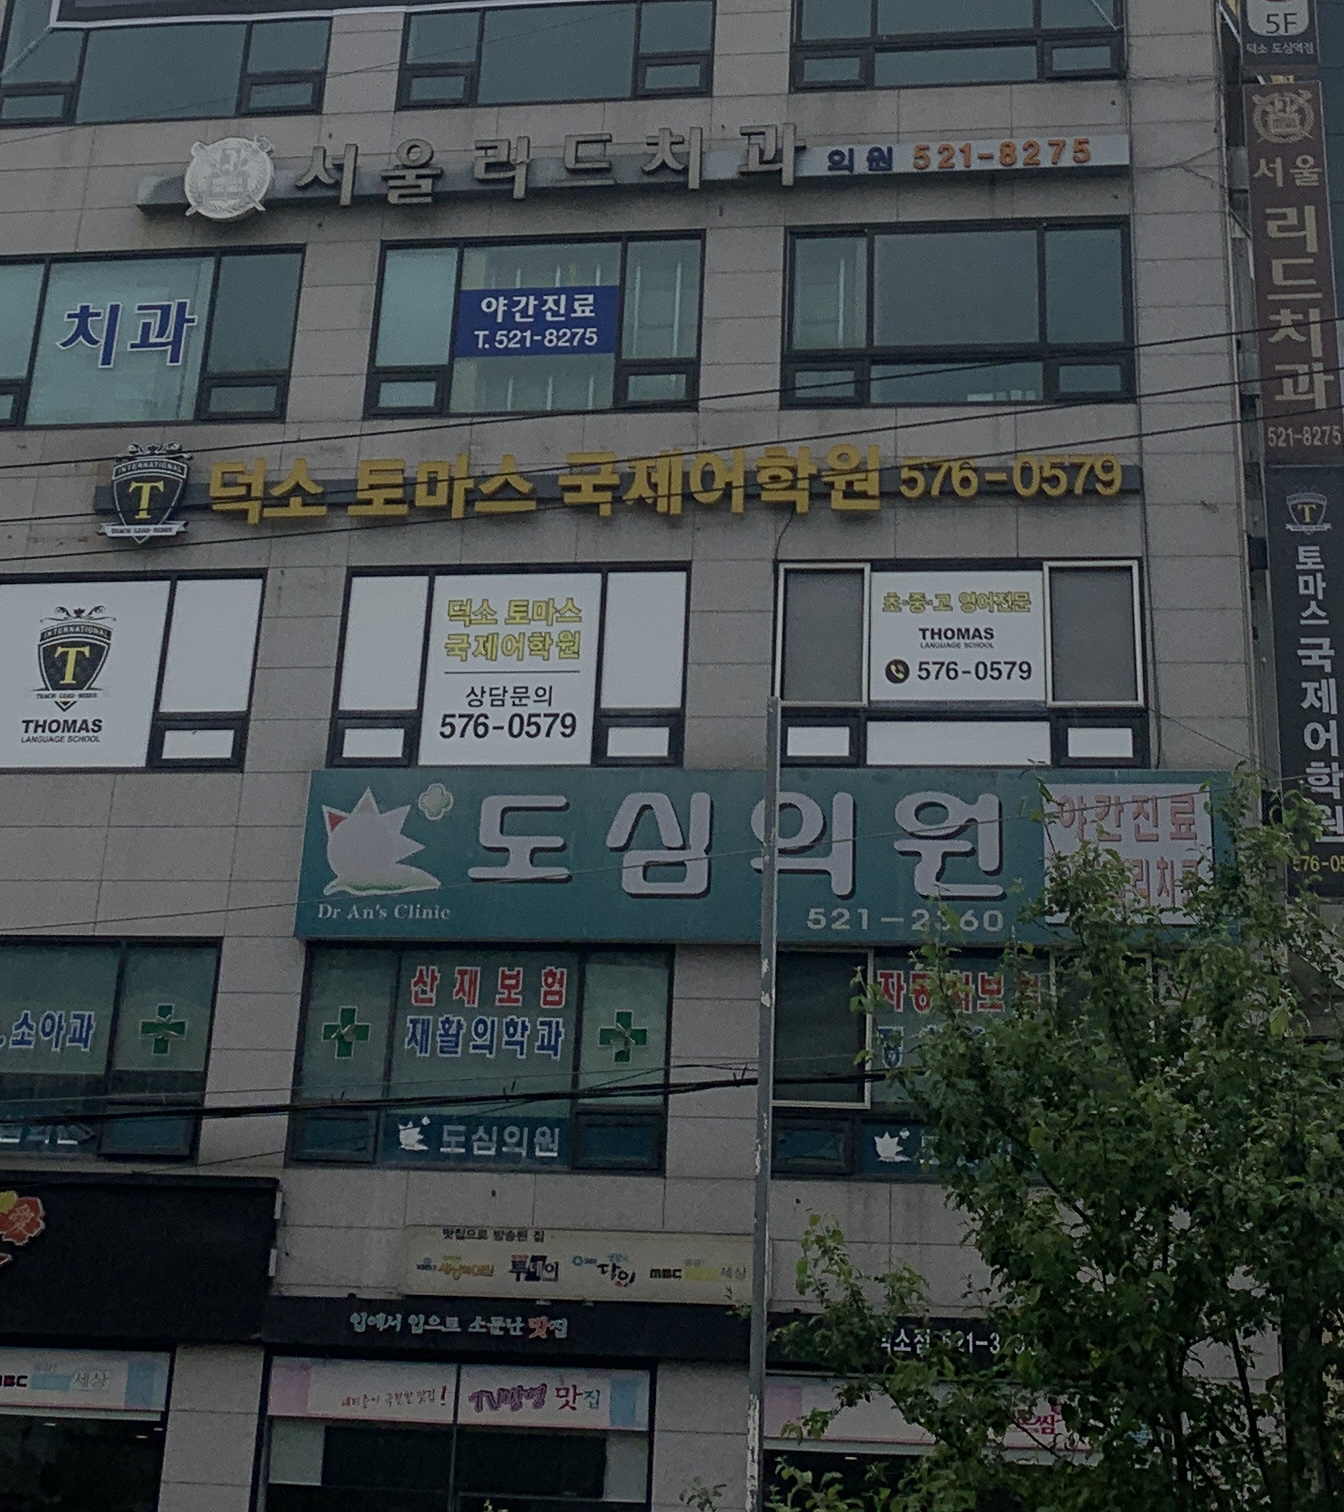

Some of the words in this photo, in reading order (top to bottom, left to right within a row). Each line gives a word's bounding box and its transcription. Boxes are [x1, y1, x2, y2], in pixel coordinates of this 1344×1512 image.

[1265, 12, 1298, 35] 5F
[826, 145, 894, 173] 의원
[912, 137, 1091, 170] 521-8275
[1252, 154, 1323, 188] 서울
[481, 293, 596, 322] 야간진료
[1264, 204, 1335, 411] 리드치과
[58, 299, 197, 369] 치과
[1267, 425, 1343, 448] 521-8275
[208, 457, 328, 526] 덕소
[348, 451, 537, 519] 토마스
[557, 443, 882, 517] 국제어학원
[899, 452, 1123, 499] 576-0579
[447, 598, 498, 627] 덕소
[504, 597, 582, 627] 토마스
[444, 630, 581, 662] 국제어학원
[919, 627, 995, 641] THOMAS
[917, 660, 1033, 681] 576-0579
[465, 685, 553, 708] 상담문의
[22, 718, 103, 734] THOMAS
[439, 712, 577, 739] 576-0579
[20, 736, 65, 744] LANGUAGE
[1058, 794, 1198, 842] 야간진료
[317, 903, 340, 921] Dr
[347, 903, 389, 921] An's
[393, 903, 451, 921] Clinic
[806, 908, 1005, 932] 521-260
[410, 965, 568, 1009] 산재보험
[404, 1015, 566, 1061] 재활의학과
[439, 1125, 560, 1158] 도심의원
[350, 1311, 402, 1333] 입에서
[408, 1313, 461, 1335] 입으로
[555, 1383, 600, 1411] 맛집
